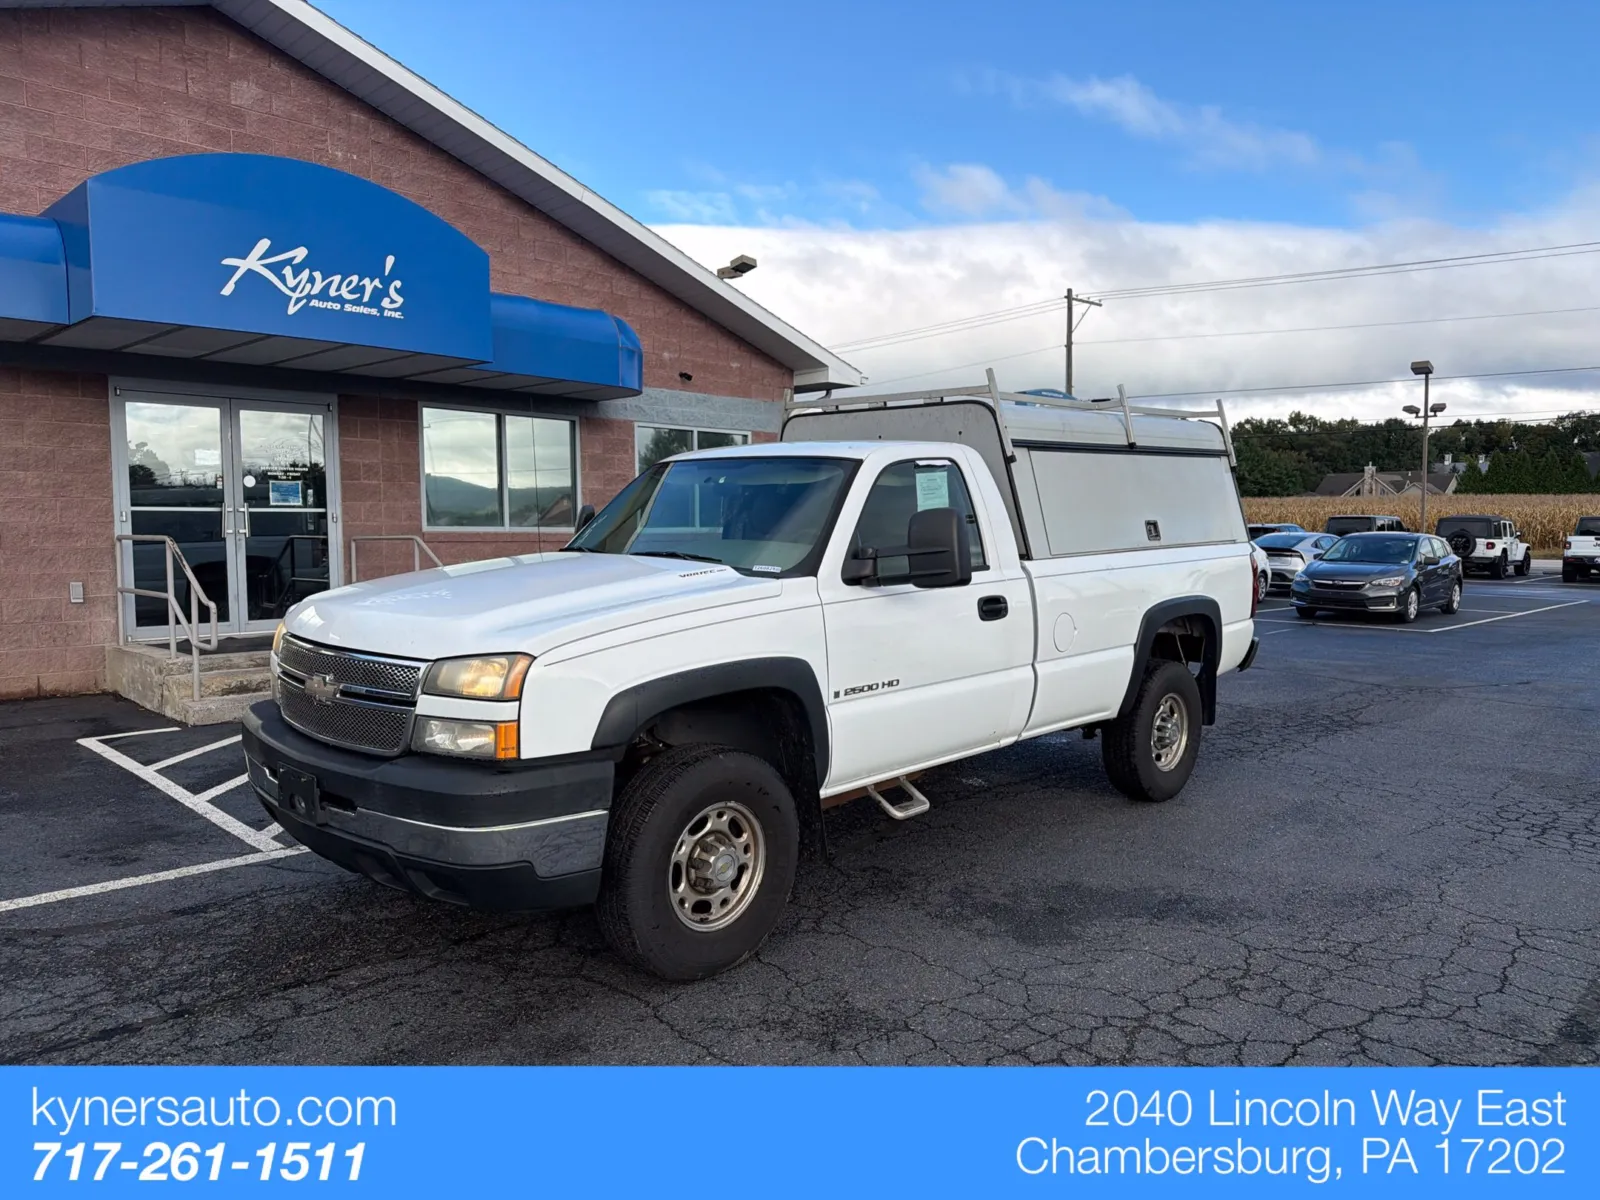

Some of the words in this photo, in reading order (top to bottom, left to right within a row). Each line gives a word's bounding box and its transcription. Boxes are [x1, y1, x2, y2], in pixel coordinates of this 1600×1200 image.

[219, 237, 404, 315] Kyner's
[309, 299, 341, 310] Auto
[344, 303, 380, 317] Sales,
[383, 309, 405, 319] Inc.
[844, 683, 879, 696] 2500
[881, 678, 900, 689] HD
